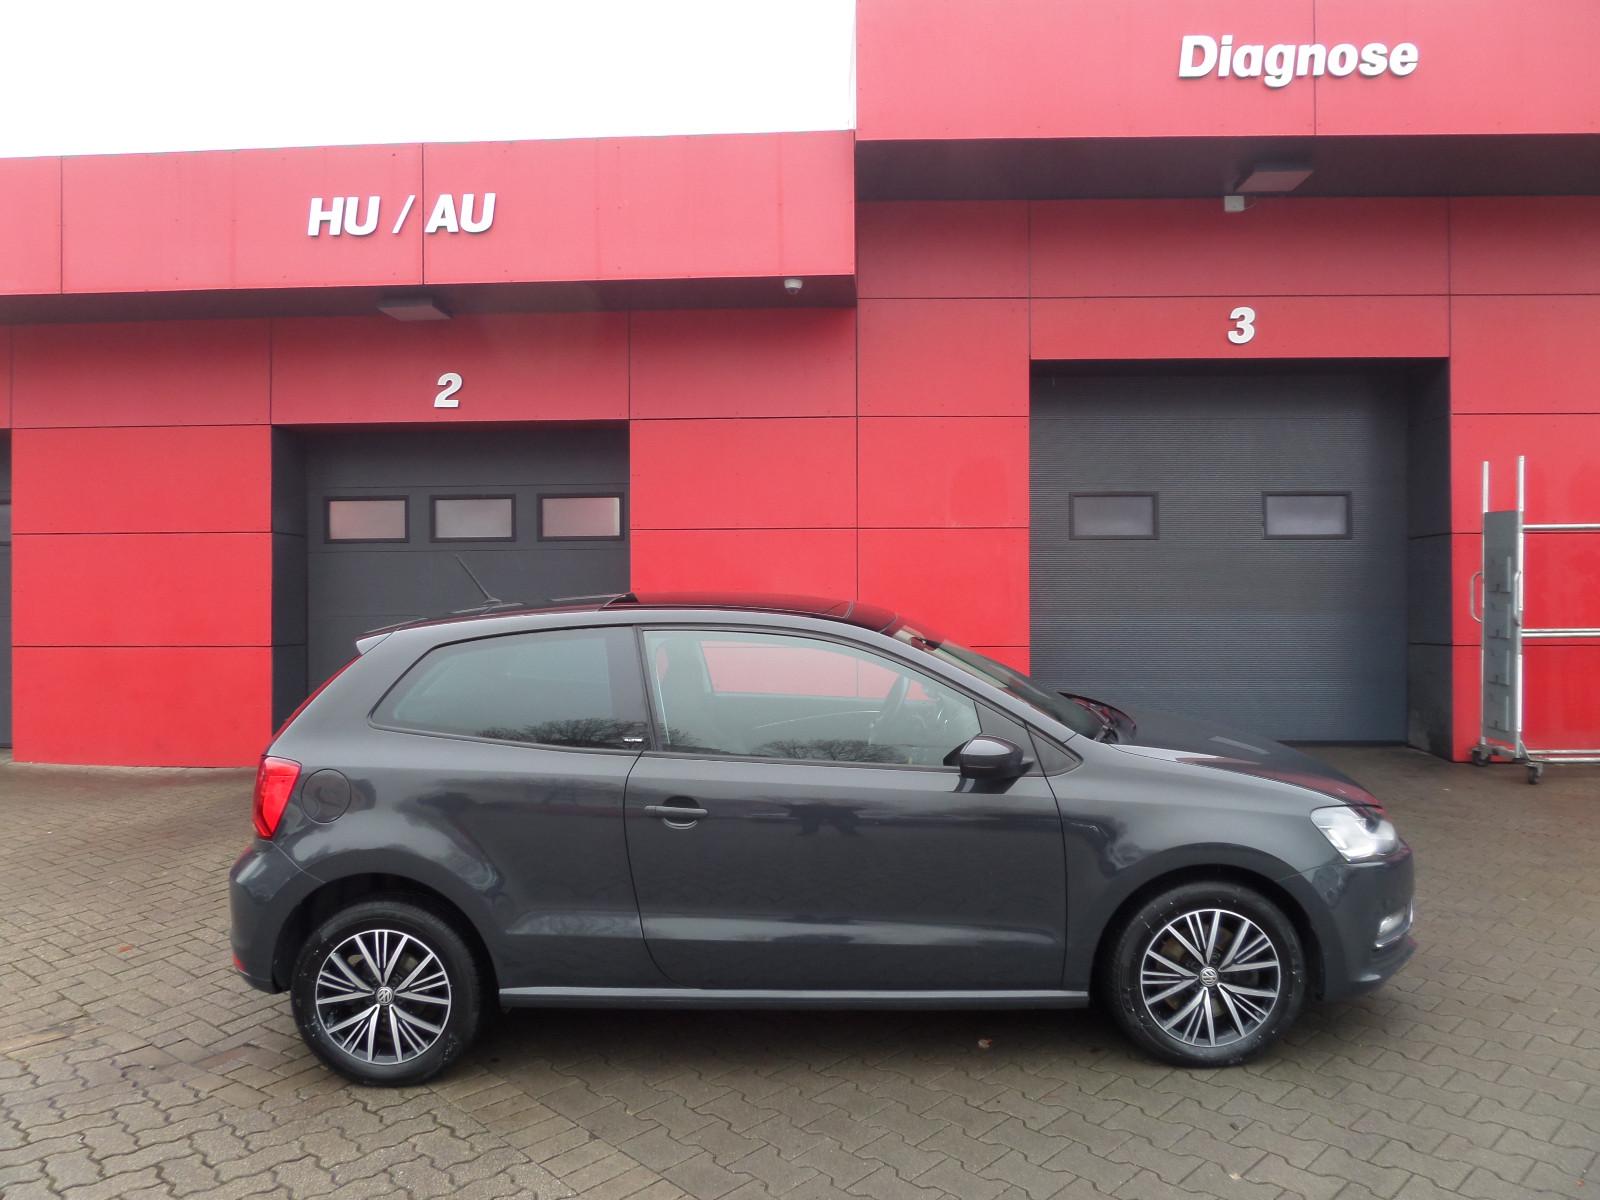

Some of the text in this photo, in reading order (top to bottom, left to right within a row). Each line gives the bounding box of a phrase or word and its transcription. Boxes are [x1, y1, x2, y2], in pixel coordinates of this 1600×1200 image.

[1178, 33, 1420, 88] Diagnose
[307, 192, 497, 236] HU / AU
[1227, 306, 1256, 345] 3
[433, 372, 463, 409] 2
